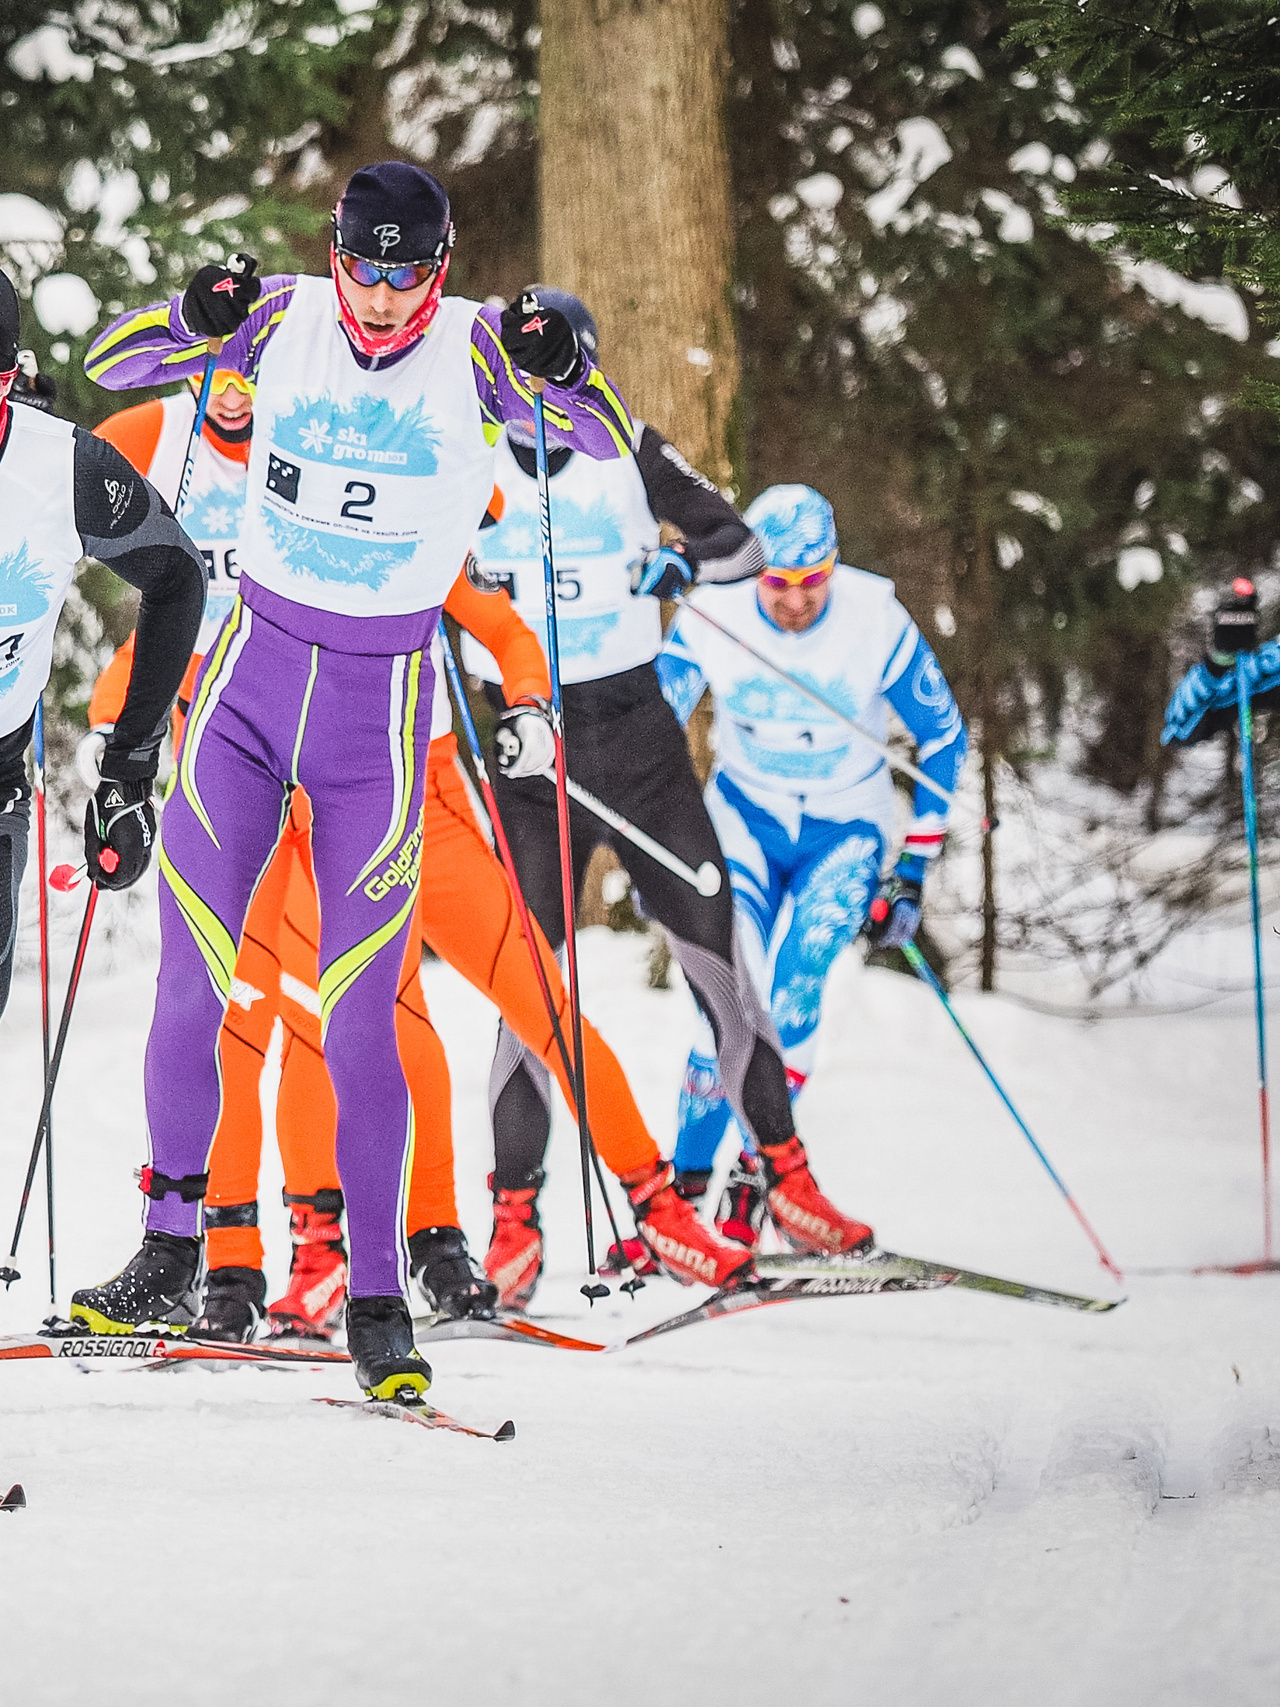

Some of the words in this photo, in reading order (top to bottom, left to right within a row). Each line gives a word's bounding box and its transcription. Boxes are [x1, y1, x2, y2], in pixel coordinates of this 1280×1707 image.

[336, 426, 367, 446] ski
[332, 443, 386, 463] grom
[340, 481, 376, 522] 2
[556, 569, 581, 600] 5
[59, 1339, 154, 1358] ROSSIGNOL
